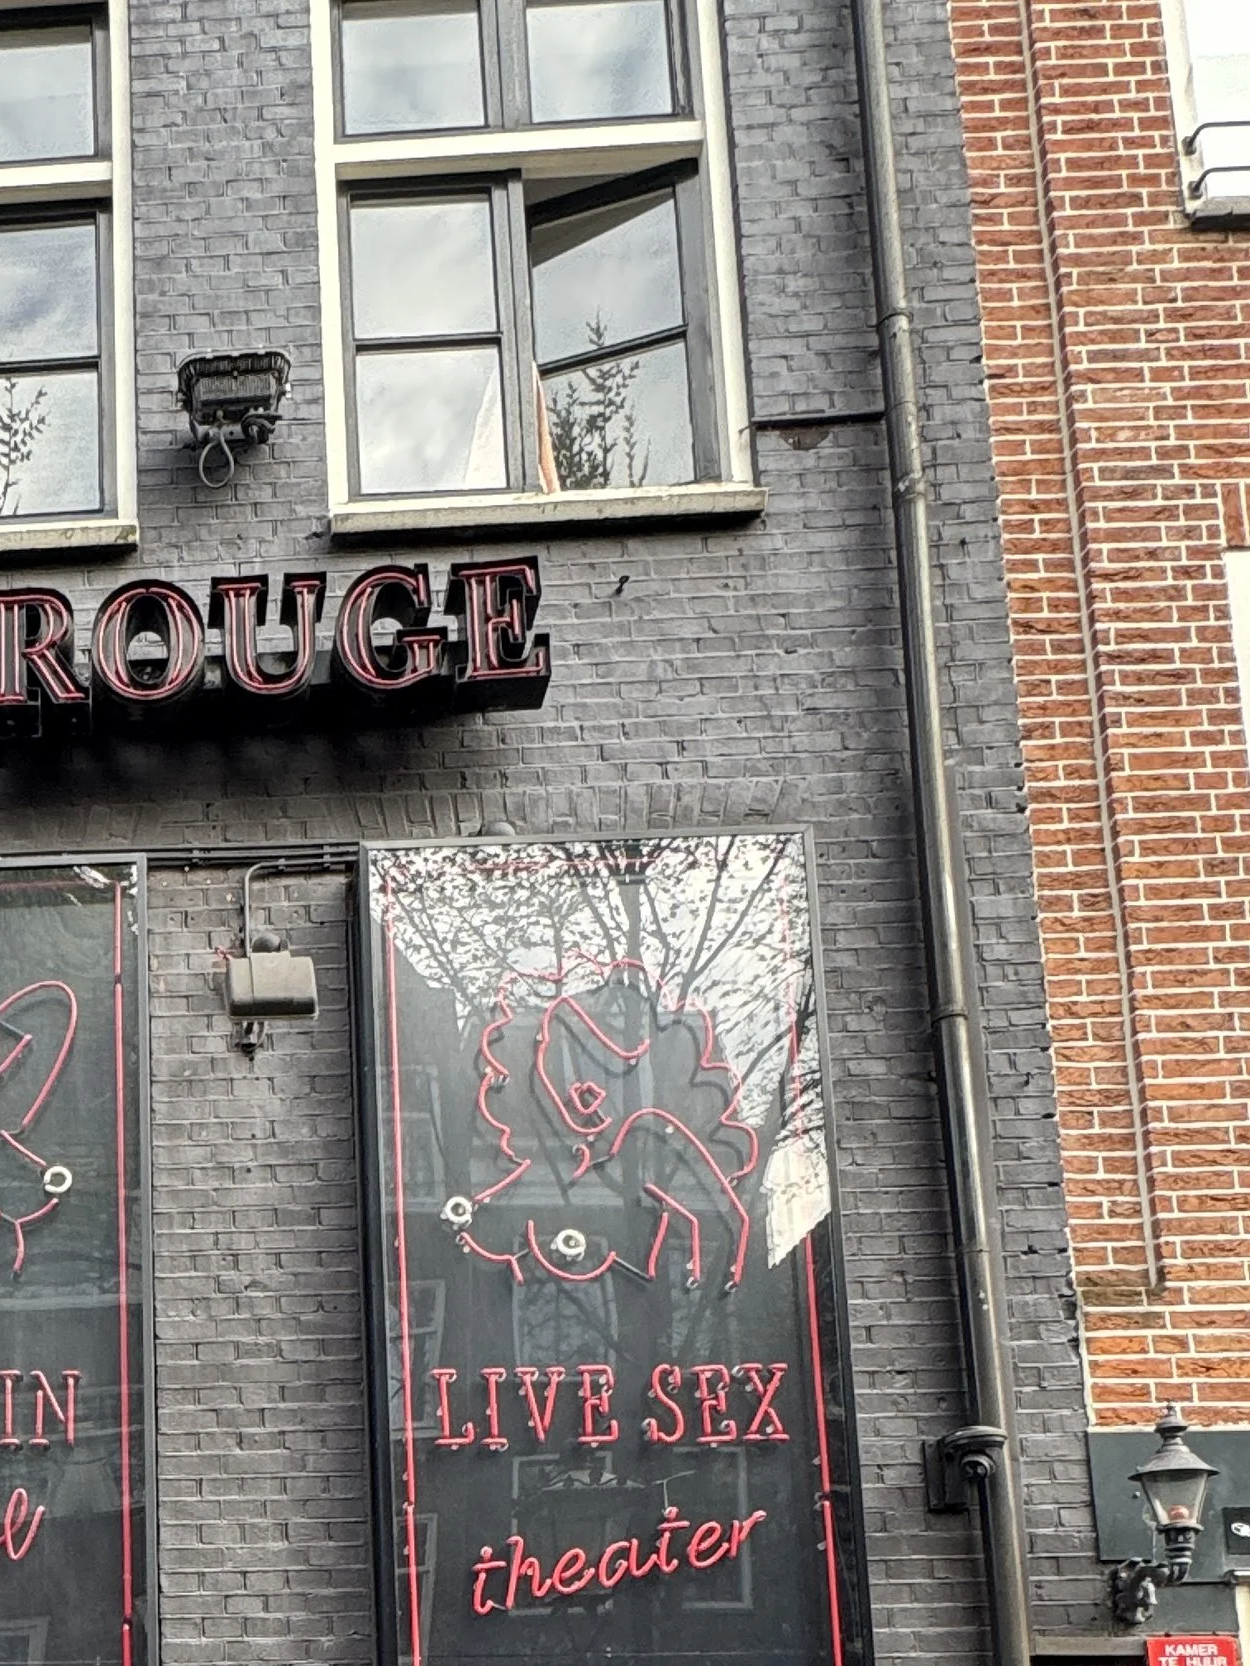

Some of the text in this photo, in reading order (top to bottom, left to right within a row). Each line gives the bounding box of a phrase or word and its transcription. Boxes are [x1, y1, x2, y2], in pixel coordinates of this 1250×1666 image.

[429, 1362, 790, 1450] LIVE SEX
[472, 1507, 767, 1615] theater
[1164, 1643, 1219, 1657] KAMER
